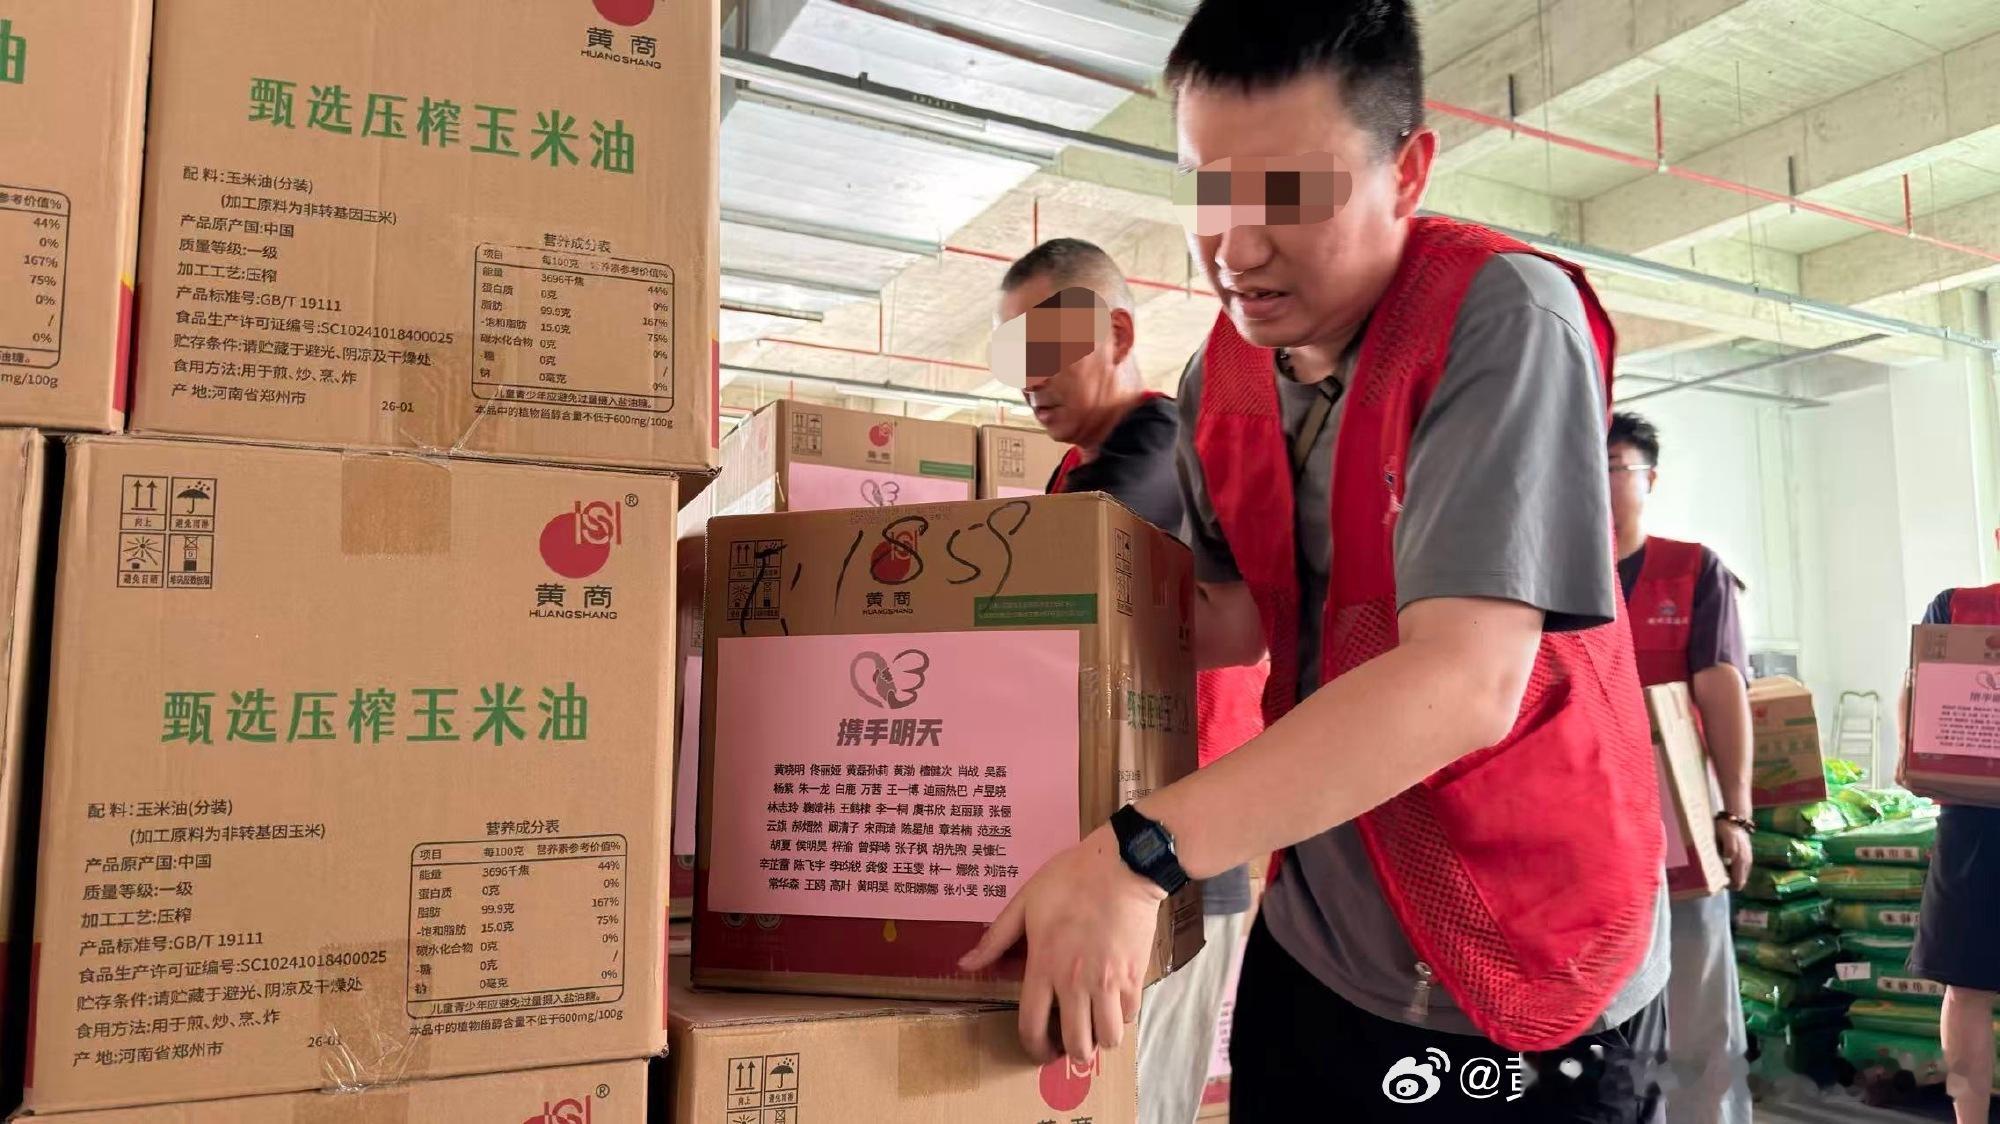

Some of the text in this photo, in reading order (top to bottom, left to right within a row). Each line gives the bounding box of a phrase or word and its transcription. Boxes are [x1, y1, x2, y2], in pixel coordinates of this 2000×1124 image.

[586, 26, 658, 58] 黄商
[580, 50, 662, 69] HUANGSHANG
[248, 76, 635, 175] 甄选压榨玉米油
[33, 217, 60, 230] 44%
[180, 214, 295, 239] 产品原产国:中国
[39, 237, 59, 249] 0%
[179, 238, 278, 260] 质量等级:一级
[24, 254, 58, 269] 167%
[29, 273, 57, 287] 75%
[176, 261, 278, 283] 加工工艺:压榨
[648, 286, 669, 296] 44%
[35, 294, 56, 306] 0%
[300, 296, 342, 312] 19111
[653, 302, 669, 312] 0%
[642, 317, 668, 328] 167%
[32, 333, 52, 344] 0%
[647, 333, 668, 344] 75%
[382, 401, 415, 414] 26-01
[535, 583, 613, 608] 黄商
[865, 591, 911, 608] 黄商
[529, 609, 618, 620] HUANGSHANG
[160, 682, 589, 746] 甄选压榨玉米油
[835, 718, 944, 748] 携手明天
[774, 764, 804, 776] 黄晓明
[958, 765, 979, 777] 肖战
[985, 766, 1007, 777] 吴磊
[773, 783, 793, 794] 杨紫
[798, 783, 830, 795] 朱一龙
[835, 783, 856, 795] 白鹿
[860, 784, 882, 795] 万茜
[887, 784, 919, 796] 王一博
[924, 784, 967, 797] 迪丽热巴
[767, 802, 798, 813] 林志玲
[129, 823, 326, 847] (加工原料为非转基因玉米)
[486, 820, 560, 836] 营养成分表
[977, 825, 1012, 838] 范丞丞
[483, 846, 525, 858] 每100克
[770, 839, 791, 851] 胡夏
[895, 841, 927, 855] 张子枫
[85, 853, 213, 874] 产品原产国:中国
[419, 860, 620, 881] 能量 3696千焦 44%
[794, 859, 826, 872] 陈飞宇
[929, 863, 951, 875] 林一
[983, 864, 1019, 878] 刘浩存
[82, 882, 194, 901] 质量等级:一级
[482, 885, 500, 897] 0克
[603, 879, 619, 889] 0%
[830, 879, 851, 892] 高叶
[592, 897, 619, 908] 167%
[80, 908, 192, 929] 加工工艺:压榨
[480, 921, 514, 934] 15.0克
[596, 915, 618, 925] 75%
[217, 932, 264, 948] 19111
[480, 941, 498, 952] 0克
[602, 933, 618, 944] 0%
[480, 959, 498, 971] 0克
[601, 969, 617, 980] 0%
